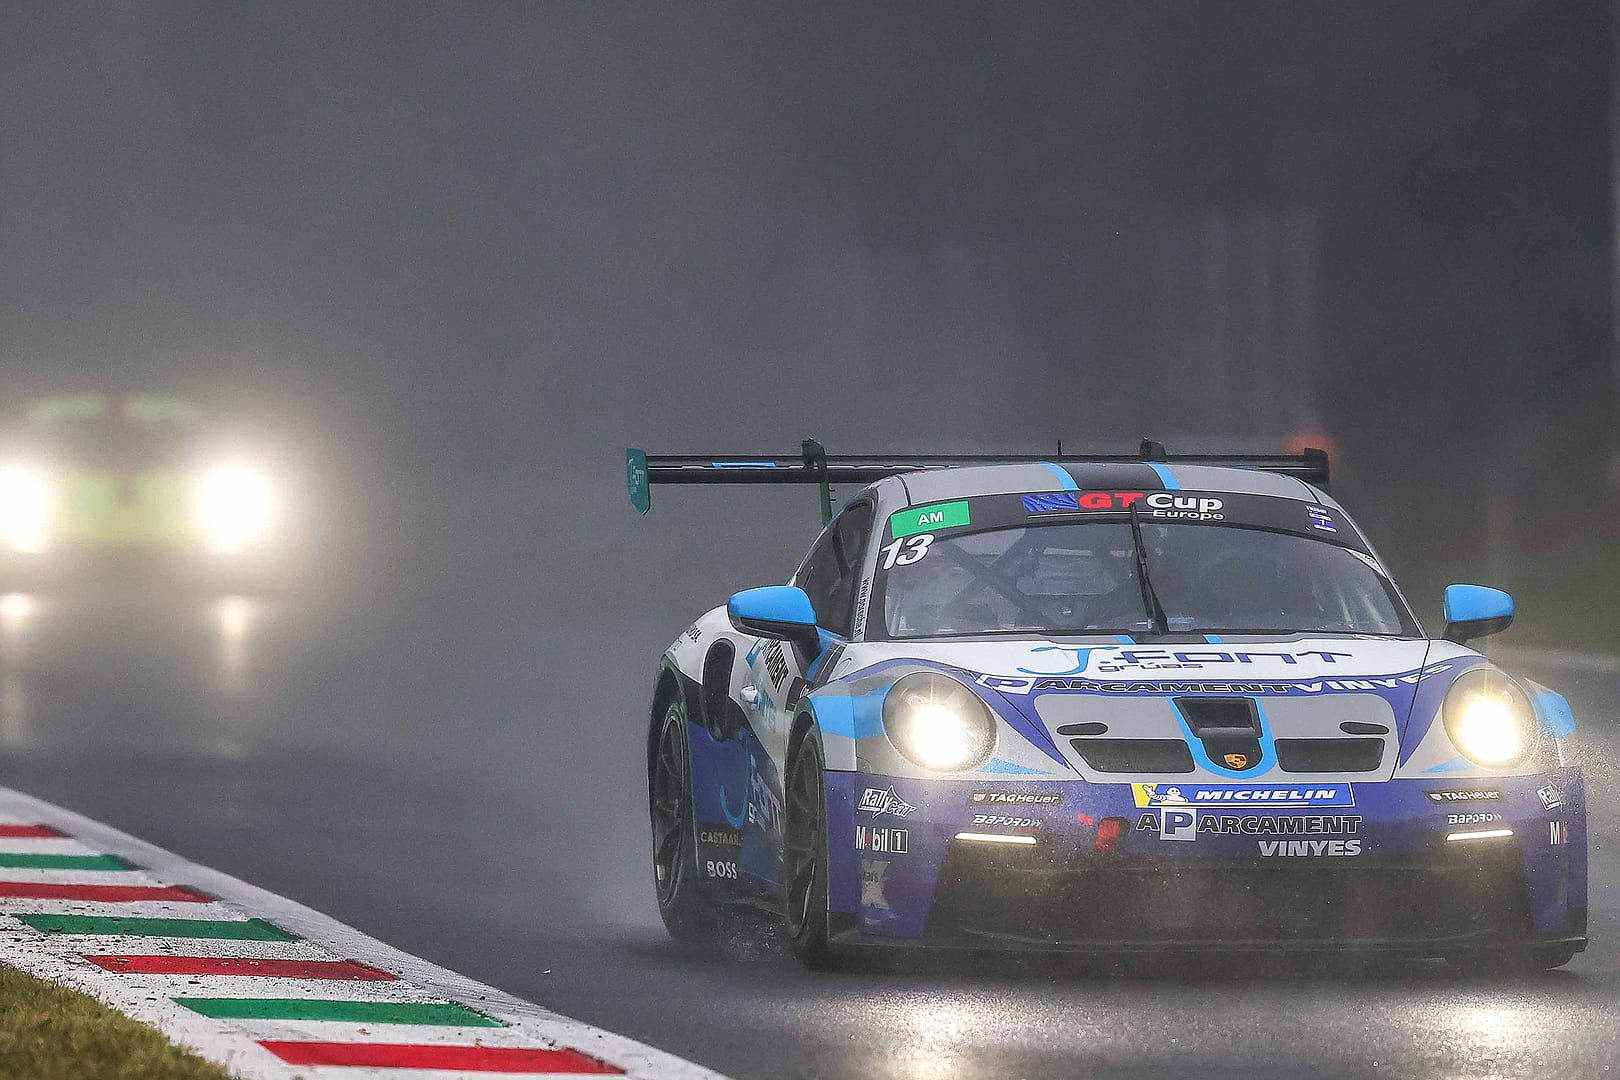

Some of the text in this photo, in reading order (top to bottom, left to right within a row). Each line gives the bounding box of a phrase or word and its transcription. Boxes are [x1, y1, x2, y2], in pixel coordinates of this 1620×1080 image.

[1079, 493, 1224, 514] GT Cup
[917, 511, 944, 526] AM
[1152, 509, 1225, 521] Europe
[880, 534, 935, 570] 13
[1195, 789, 1337, 801] MICHELIN
[855, 825, 889, 852] Mobil
[1258, 840, 1362, 857] VINYES
[706, 860, 738, 880] BOSS
